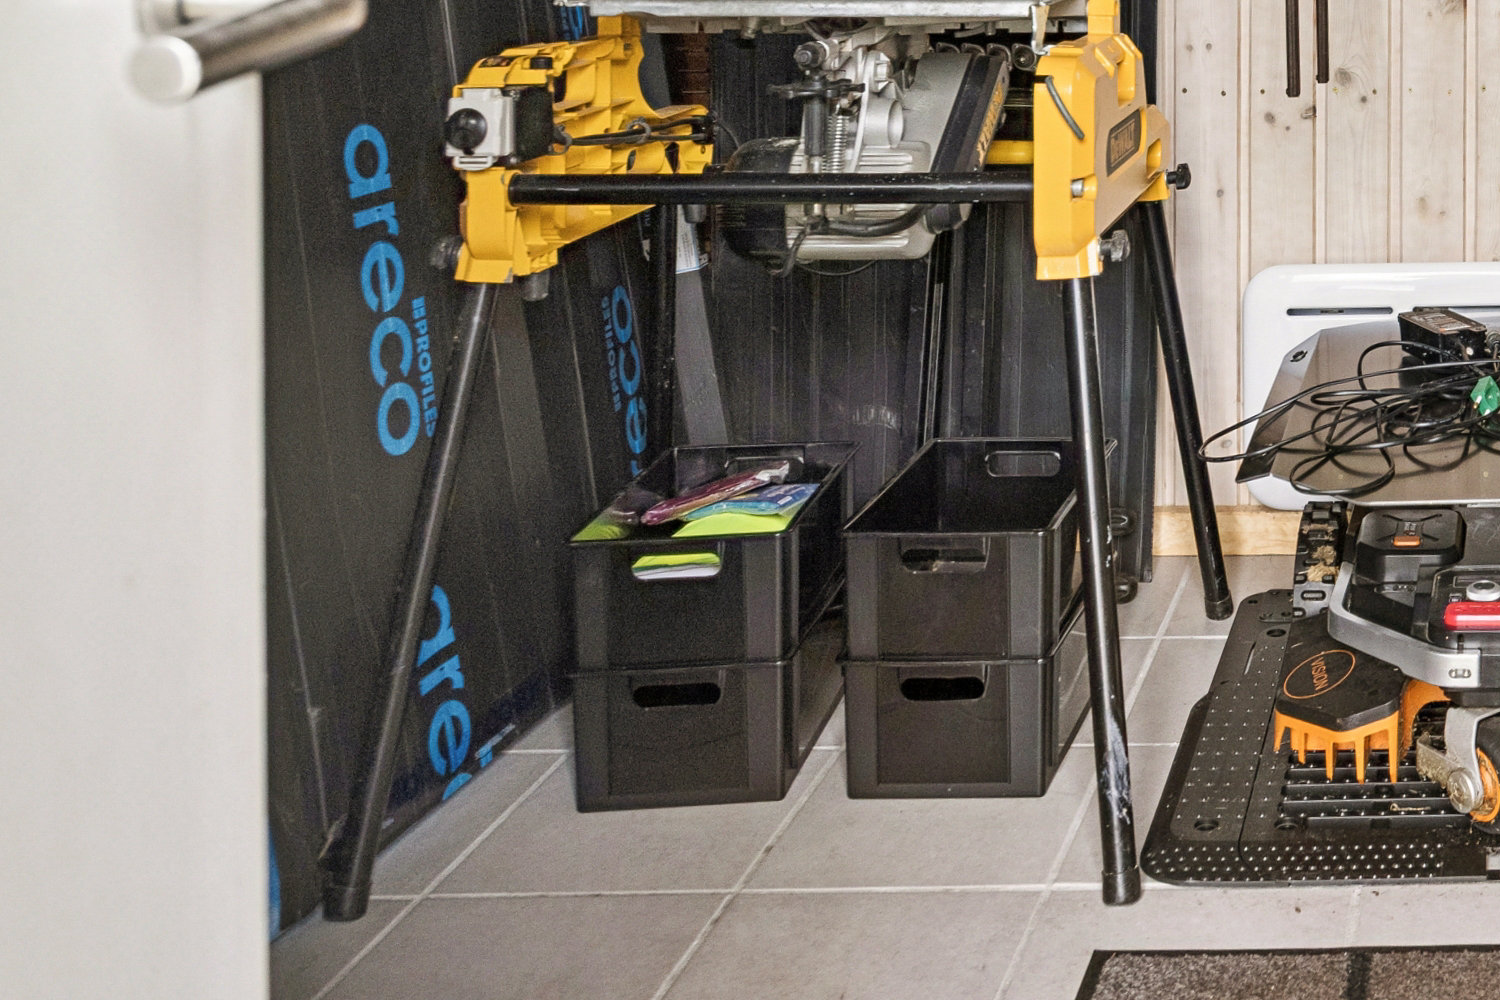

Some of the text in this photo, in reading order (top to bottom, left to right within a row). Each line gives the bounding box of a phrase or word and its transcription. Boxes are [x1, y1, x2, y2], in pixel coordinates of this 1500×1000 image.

[343, 123, 421, 457] areco
[414, 318, 439, 438] PROFILES
[1311, 657, 1329, 691] VISION
